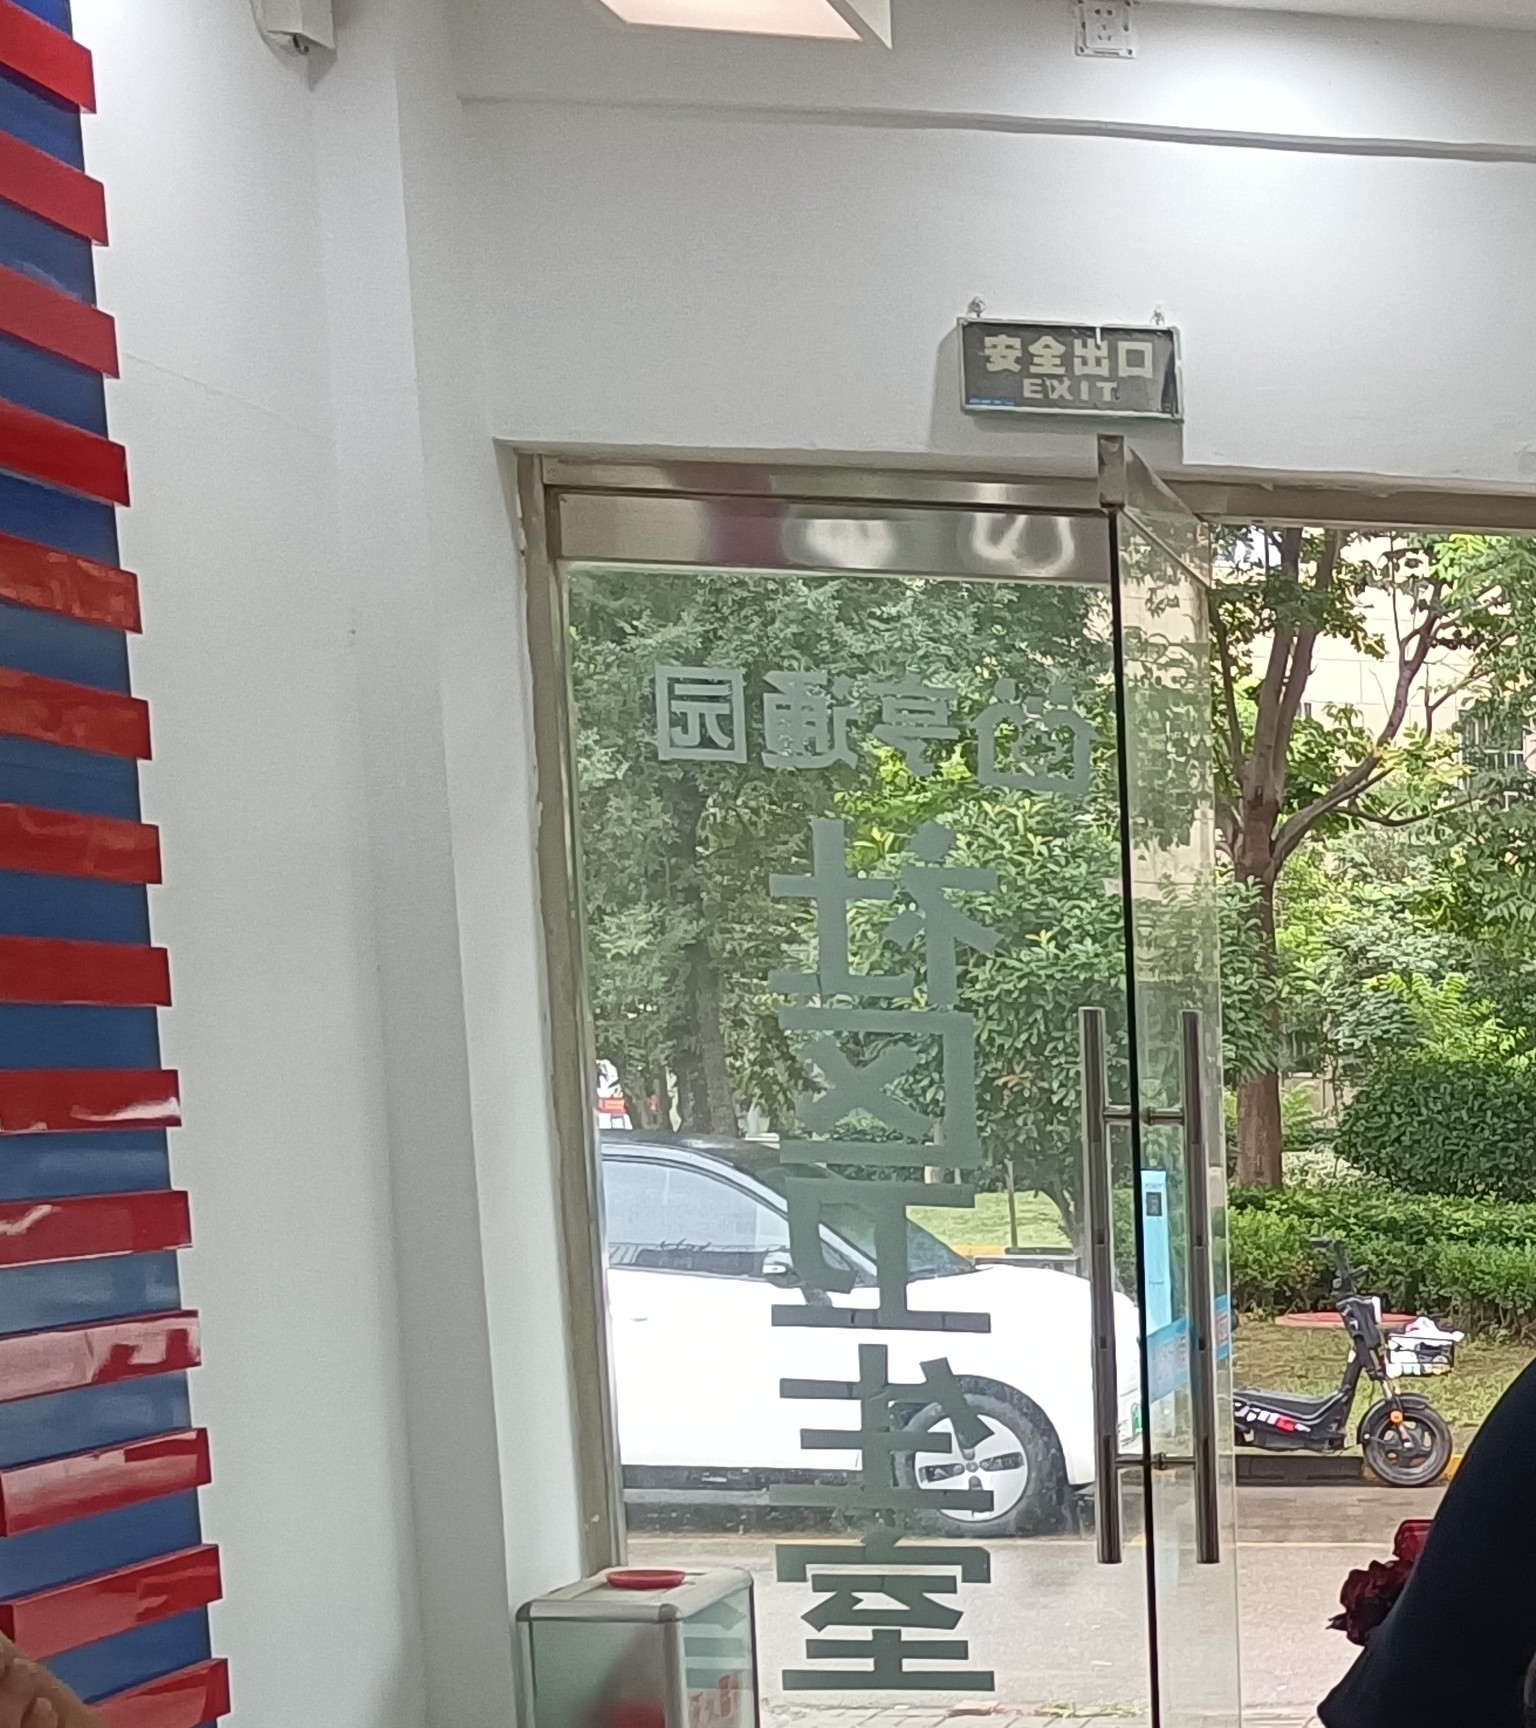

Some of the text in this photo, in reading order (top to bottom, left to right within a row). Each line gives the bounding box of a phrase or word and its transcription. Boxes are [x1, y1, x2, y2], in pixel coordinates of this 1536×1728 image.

[983, 334, 1154, 379] 安全出口
[1023, 376, 1119, 401] EXIT
